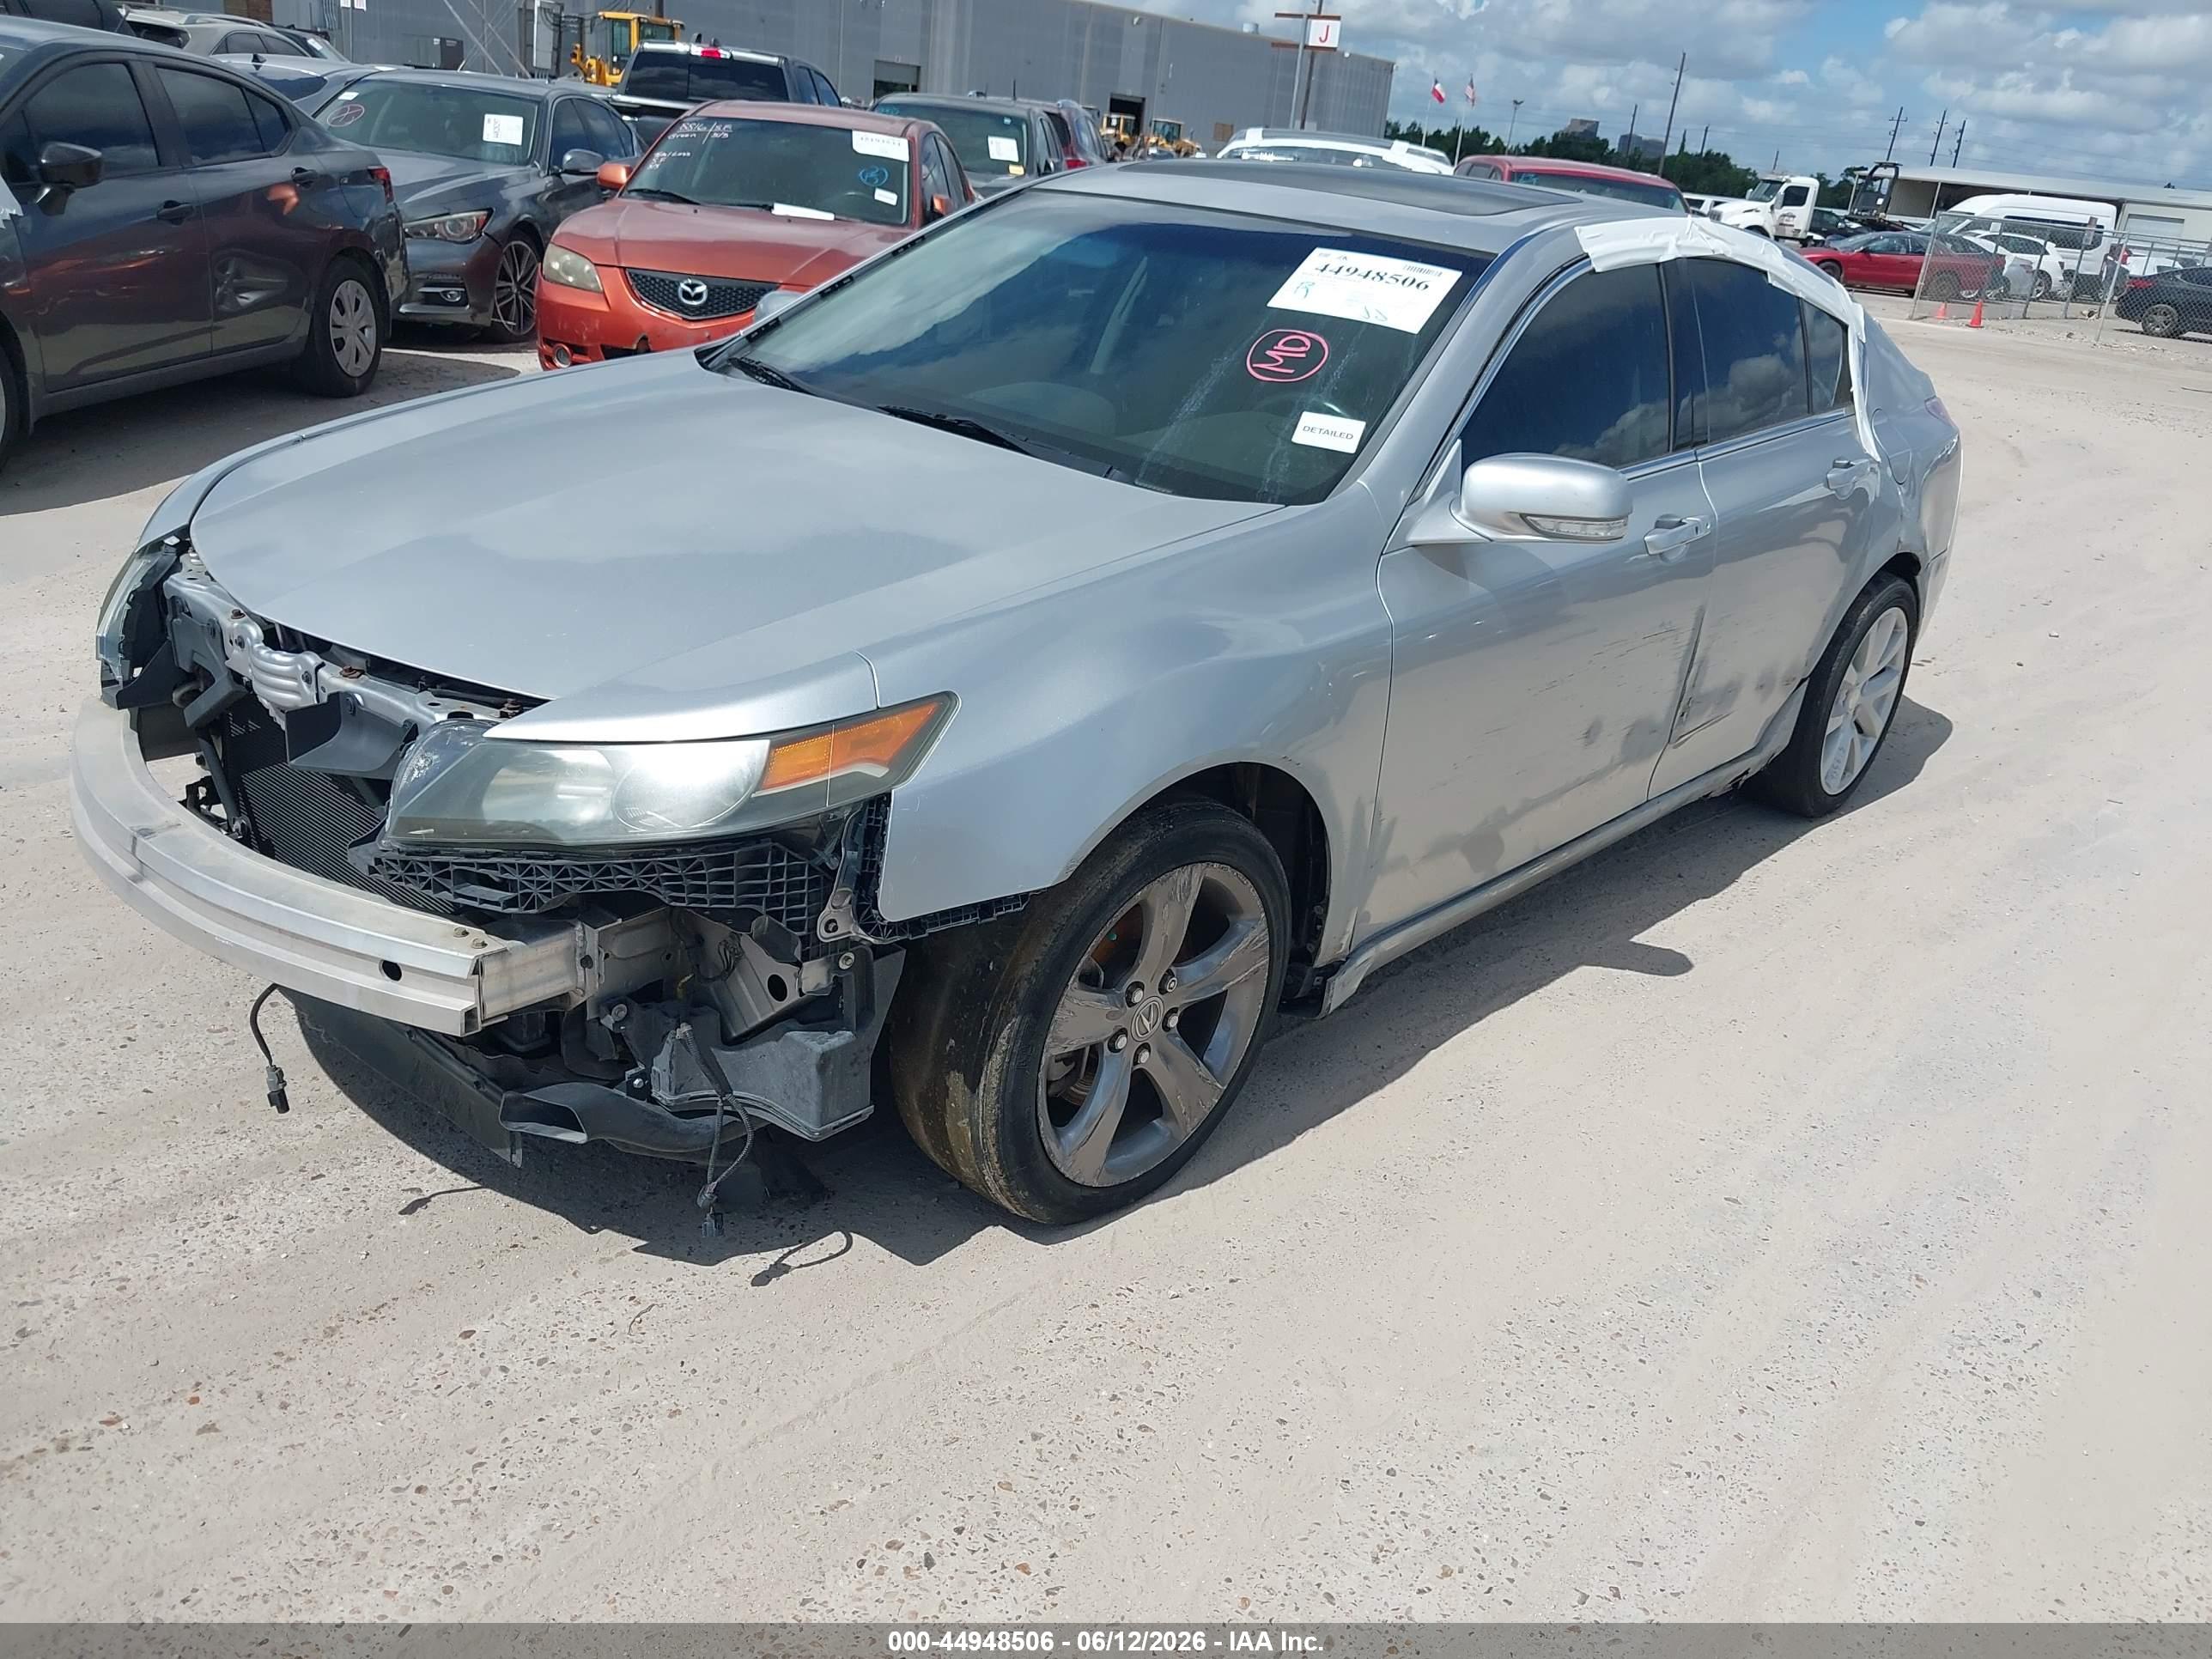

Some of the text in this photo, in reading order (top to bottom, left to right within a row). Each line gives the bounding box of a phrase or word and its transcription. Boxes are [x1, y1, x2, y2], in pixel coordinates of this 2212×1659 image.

[1319, 24, 1329, 43] J
[1315, 263, 1430, 292] 44948506
[1302, 424, 1355, 441] DETAILED
